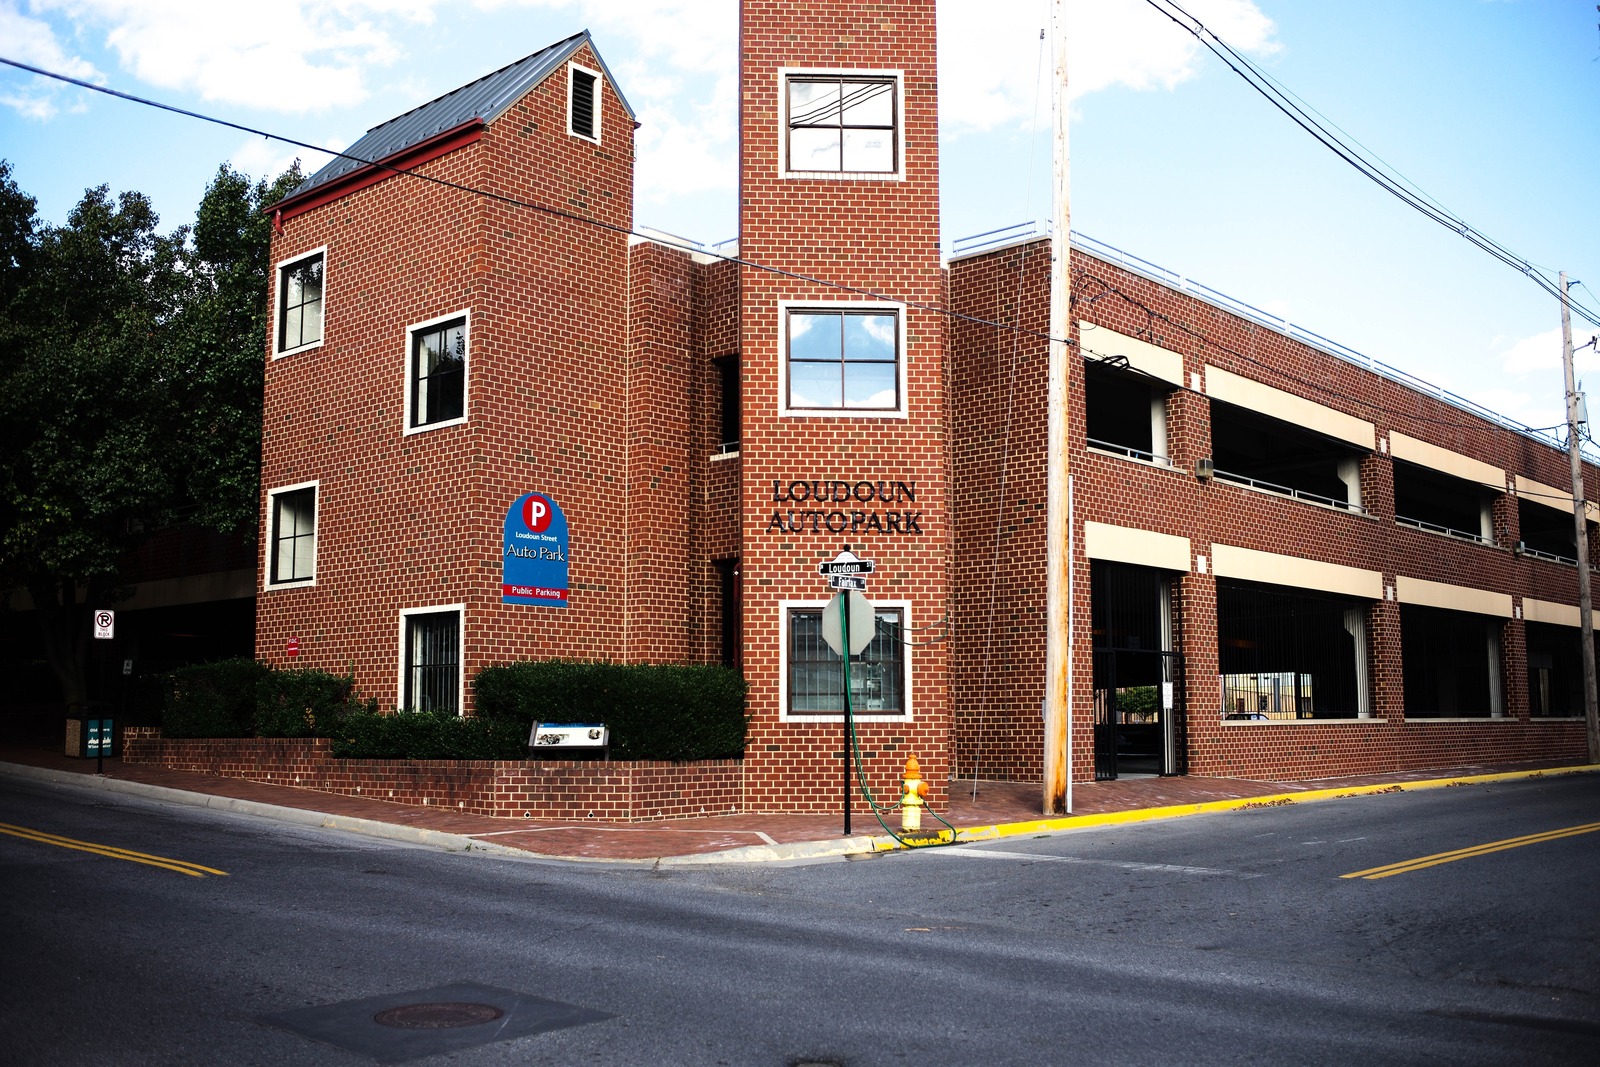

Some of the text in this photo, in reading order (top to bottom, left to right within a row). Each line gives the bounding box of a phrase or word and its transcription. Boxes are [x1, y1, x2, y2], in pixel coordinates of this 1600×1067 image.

[773, 480, 915, 503] LOUDOUN
[531, 501, 546, 526] P
[766, 510, 923, 534] AUTOPARK
[515, 531, 557, 543] Loudoun Street
[506, 544, 566, 562] Auto Park
[828, 563, 860, 573] Loudoun
[838, 577, 857, 588] Fairfax
[512, 586, 560, 599] Public Parking
